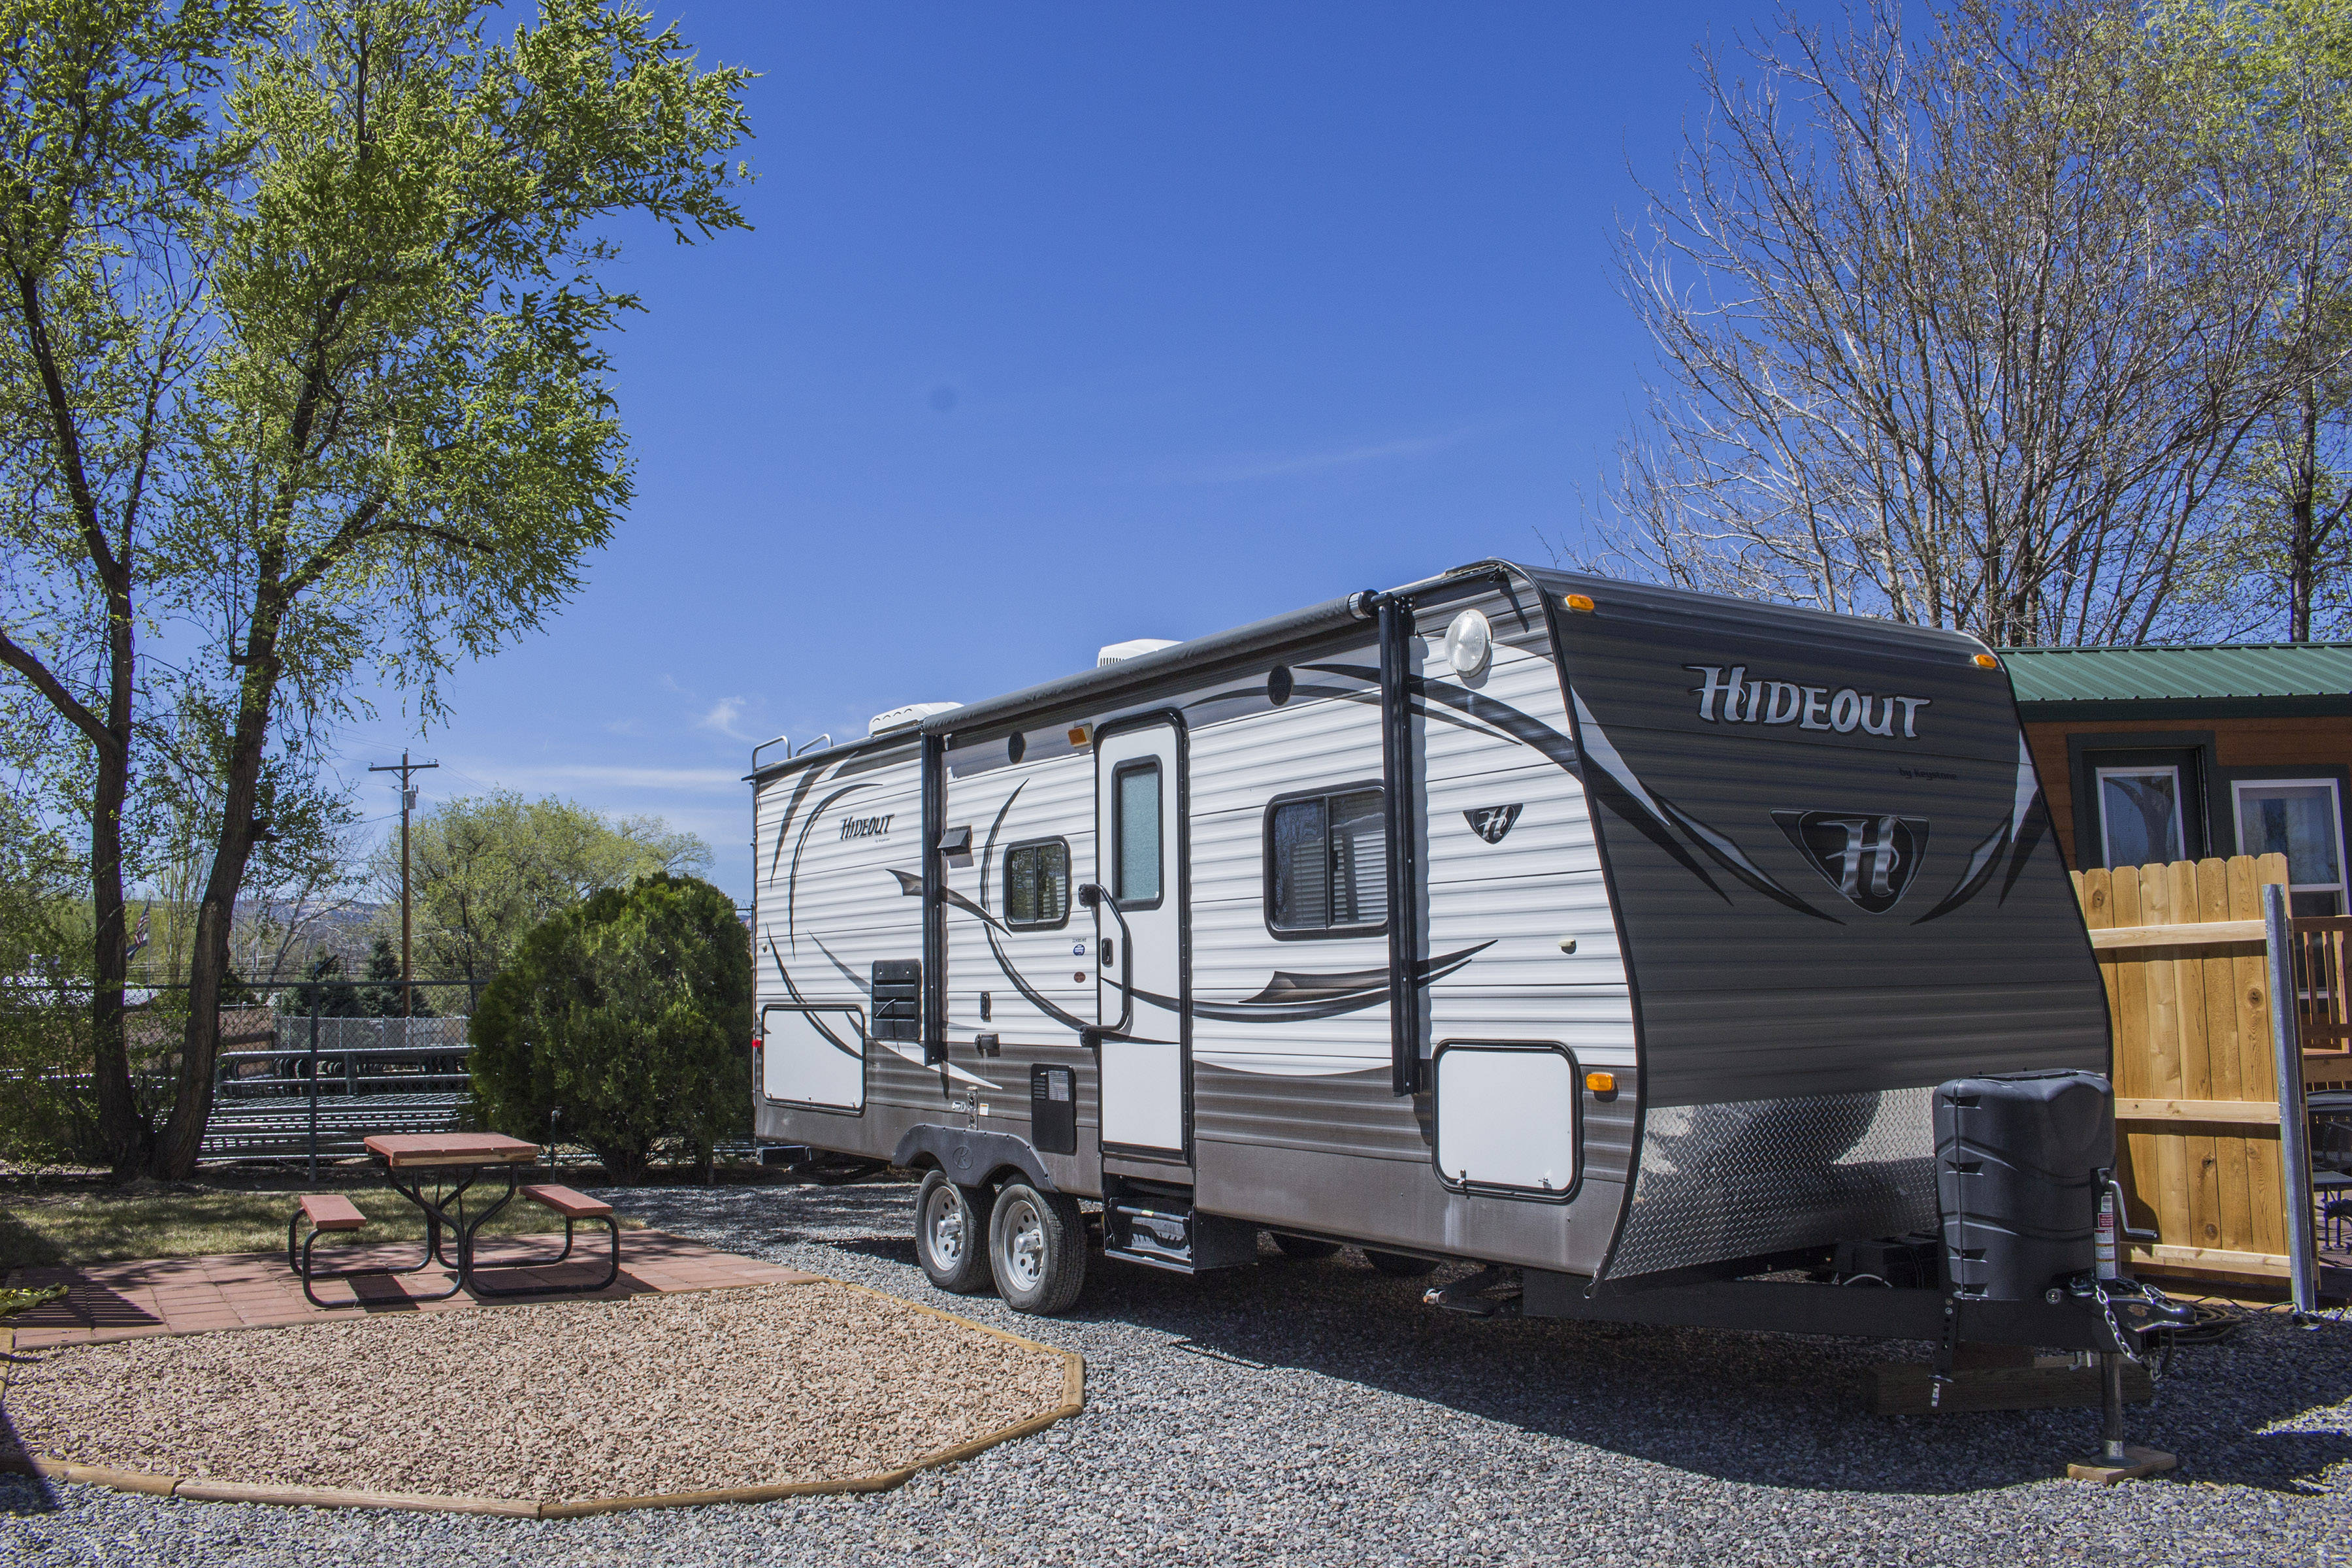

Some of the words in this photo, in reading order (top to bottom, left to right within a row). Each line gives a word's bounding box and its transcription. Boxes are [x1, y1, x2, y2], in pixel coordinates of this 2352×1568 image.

[1683, 664, 1931, 739] HIDEOUT
[1898, 767, 1912, 779] by
[1913, 768, 1957, 781] Keystone
[840, 813, 894, 841] HIDEOUT
